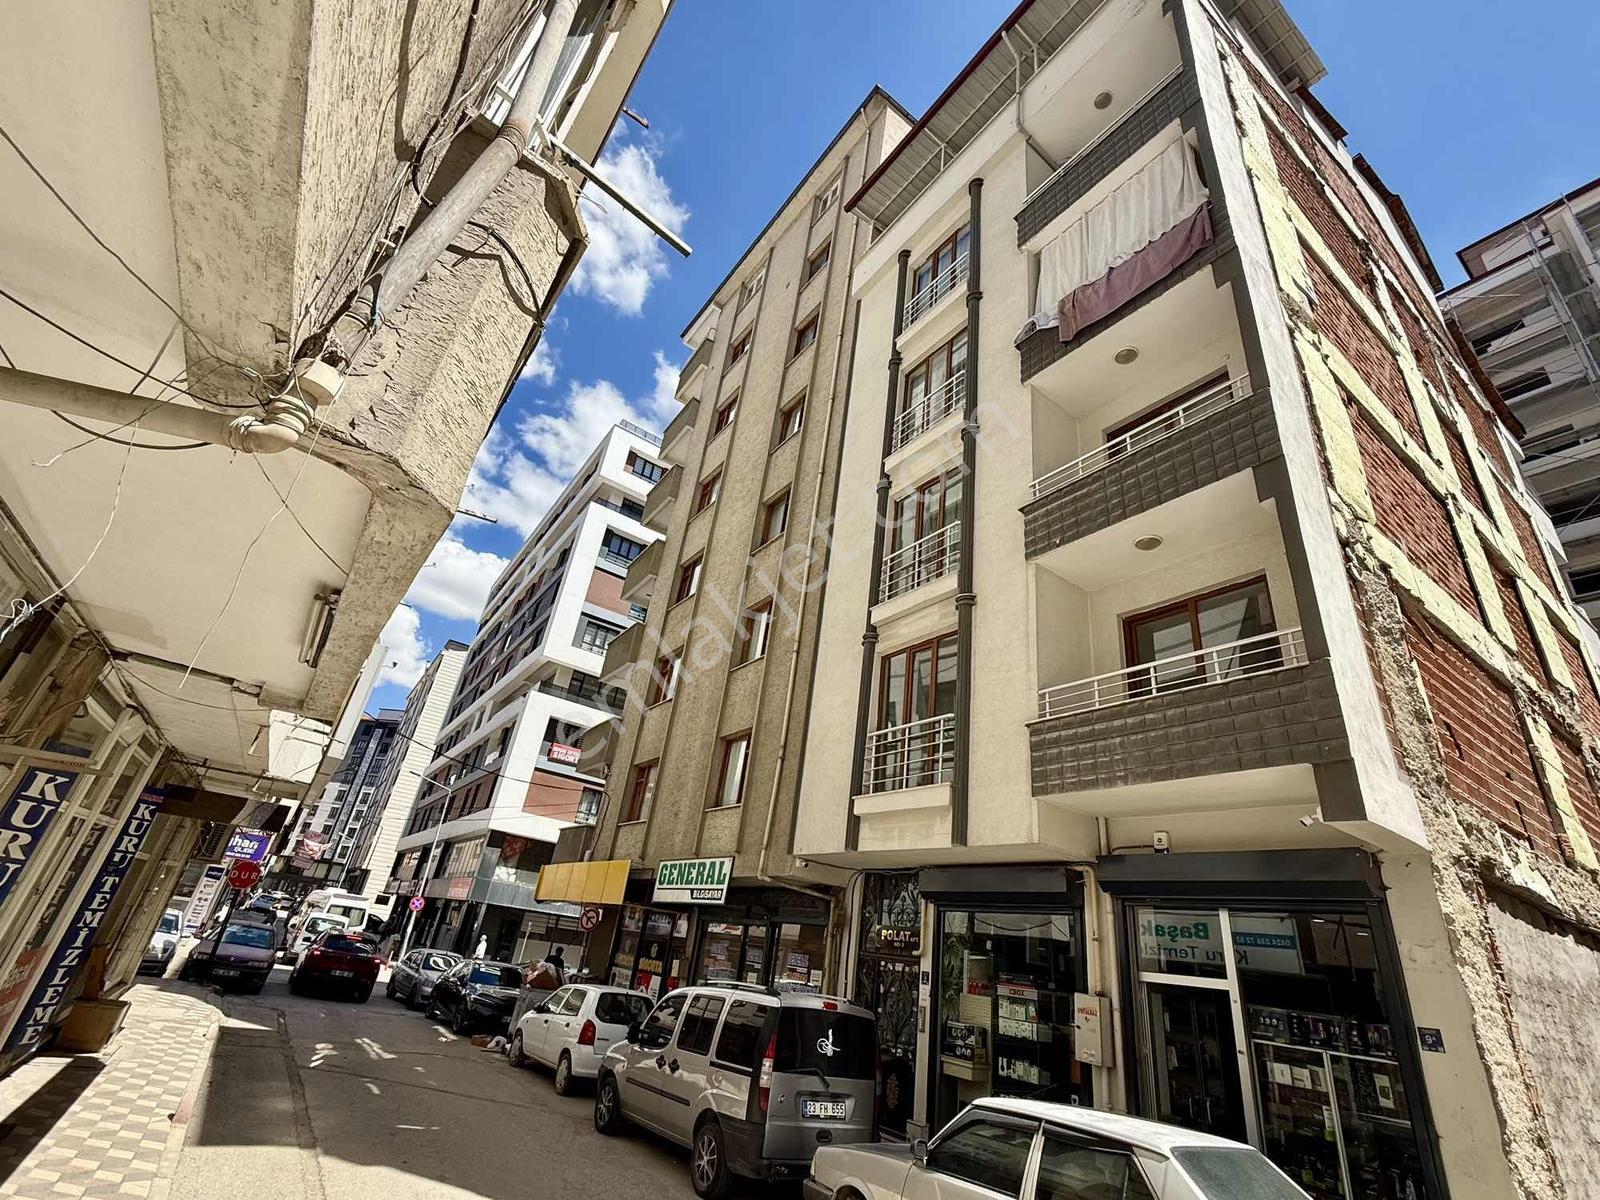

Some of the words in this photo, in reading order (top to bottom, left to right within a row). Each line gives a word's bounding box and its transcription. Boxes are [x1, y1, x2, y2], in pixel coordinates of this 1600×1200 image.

[112, 803, 157, 868] KURU
[230, 870, 258, 880] DUR
[658, 861, 727, 886] GENERAL
[881, 930, 911, 941] POLAT
[19, 876, 119, 1044] TEMİZLEME
[808, 1102, 816, 1113] 23
[820, 1103, 829, 1114] FH
